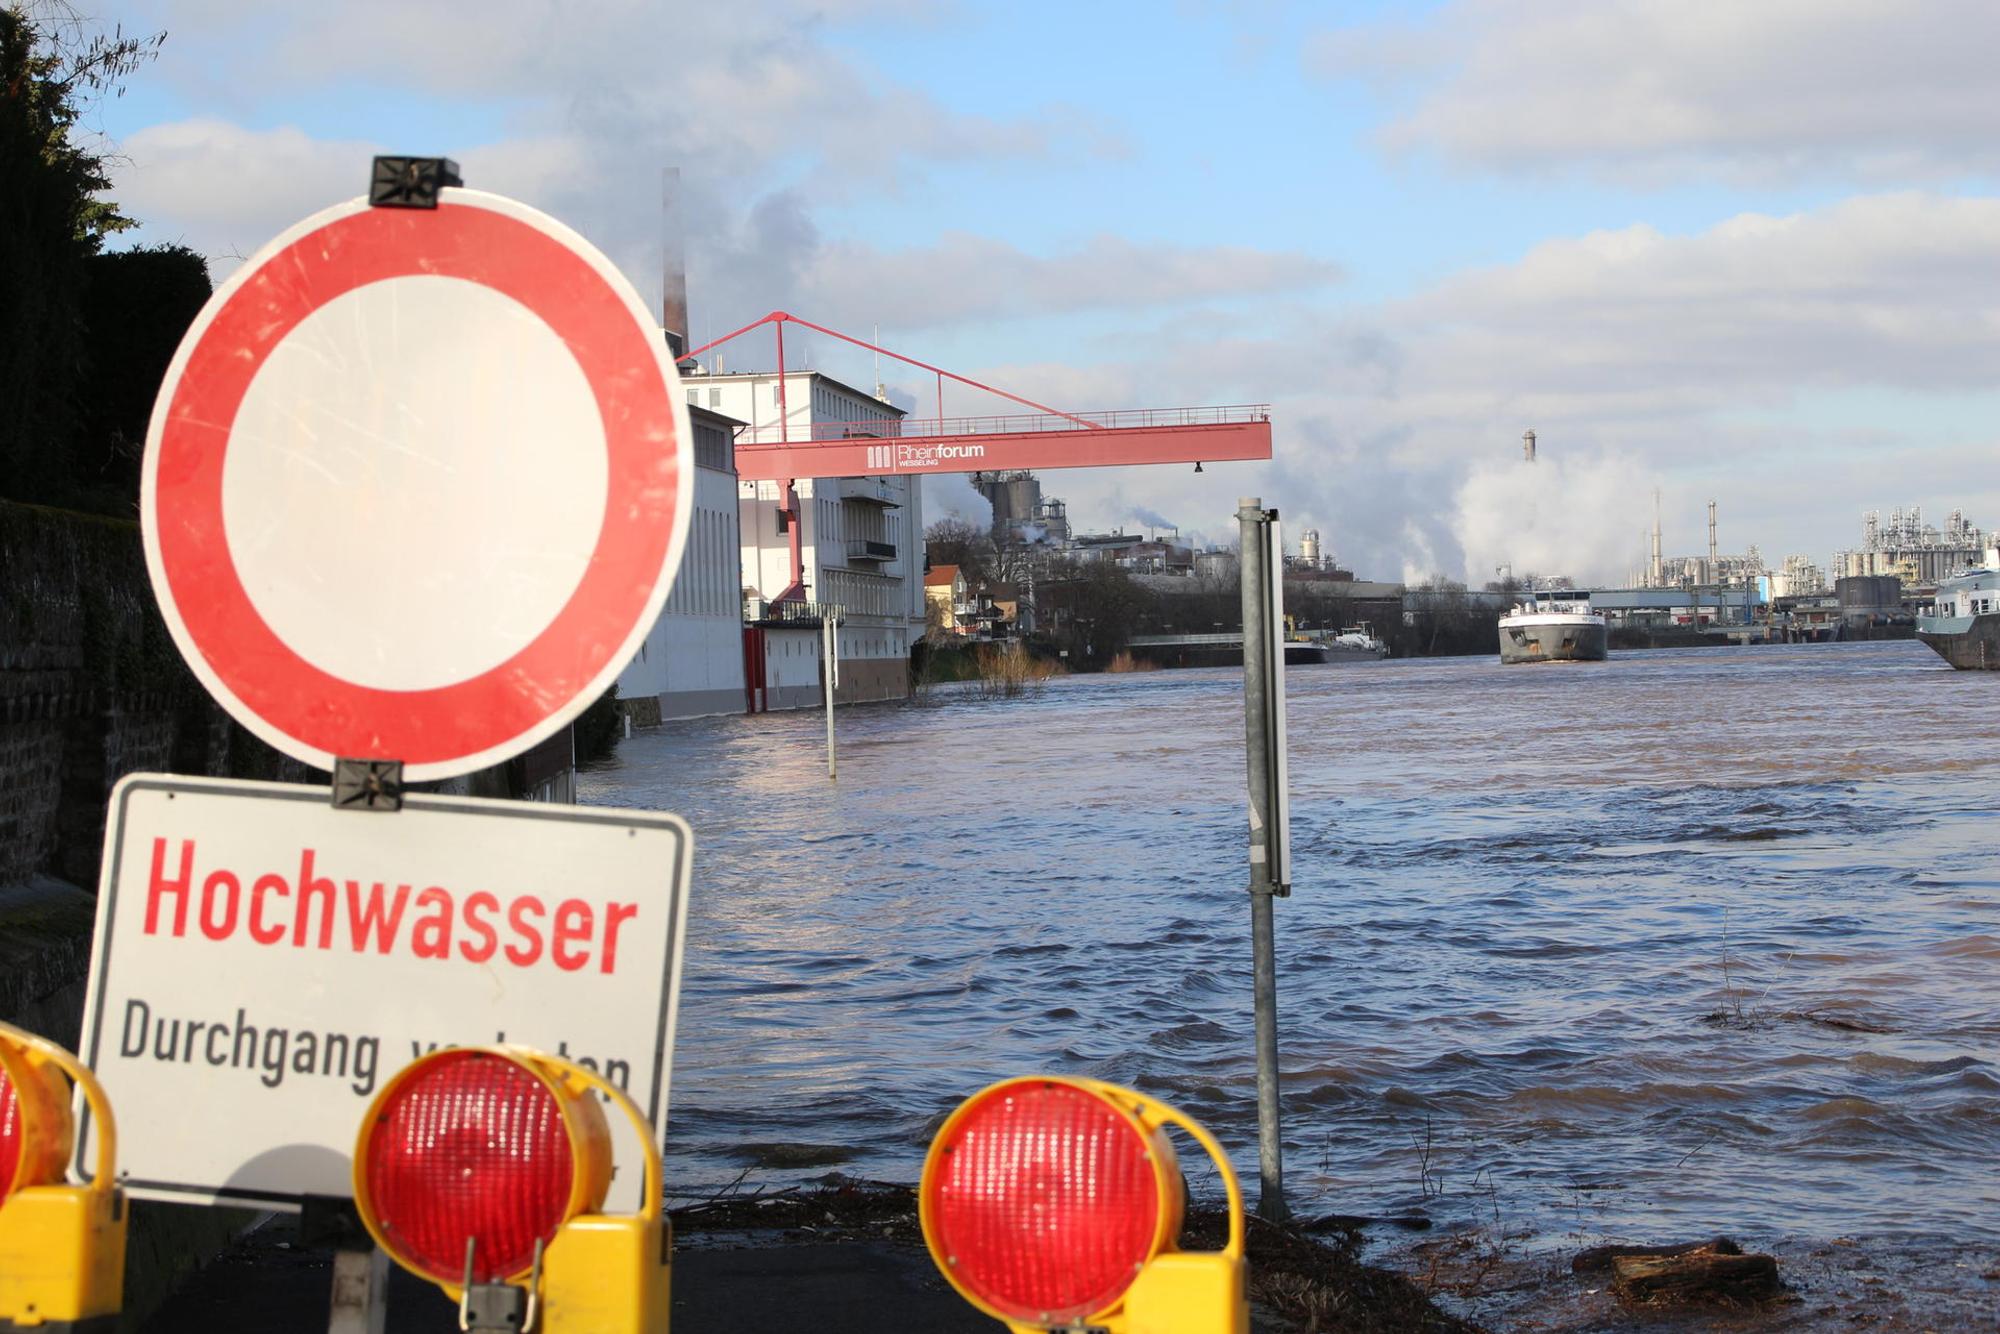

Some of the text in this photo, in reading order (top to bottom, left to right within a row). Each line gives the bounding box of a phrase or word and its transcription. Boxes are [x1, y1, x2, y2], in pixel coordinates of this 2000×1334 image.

[898, 443, 984, 460] Rheinforum
[898, 459, 939, 467] WESSELING
[143, 838, 638, 974] Hochwasser
[121, 998, 380, 1095] Durchgang
